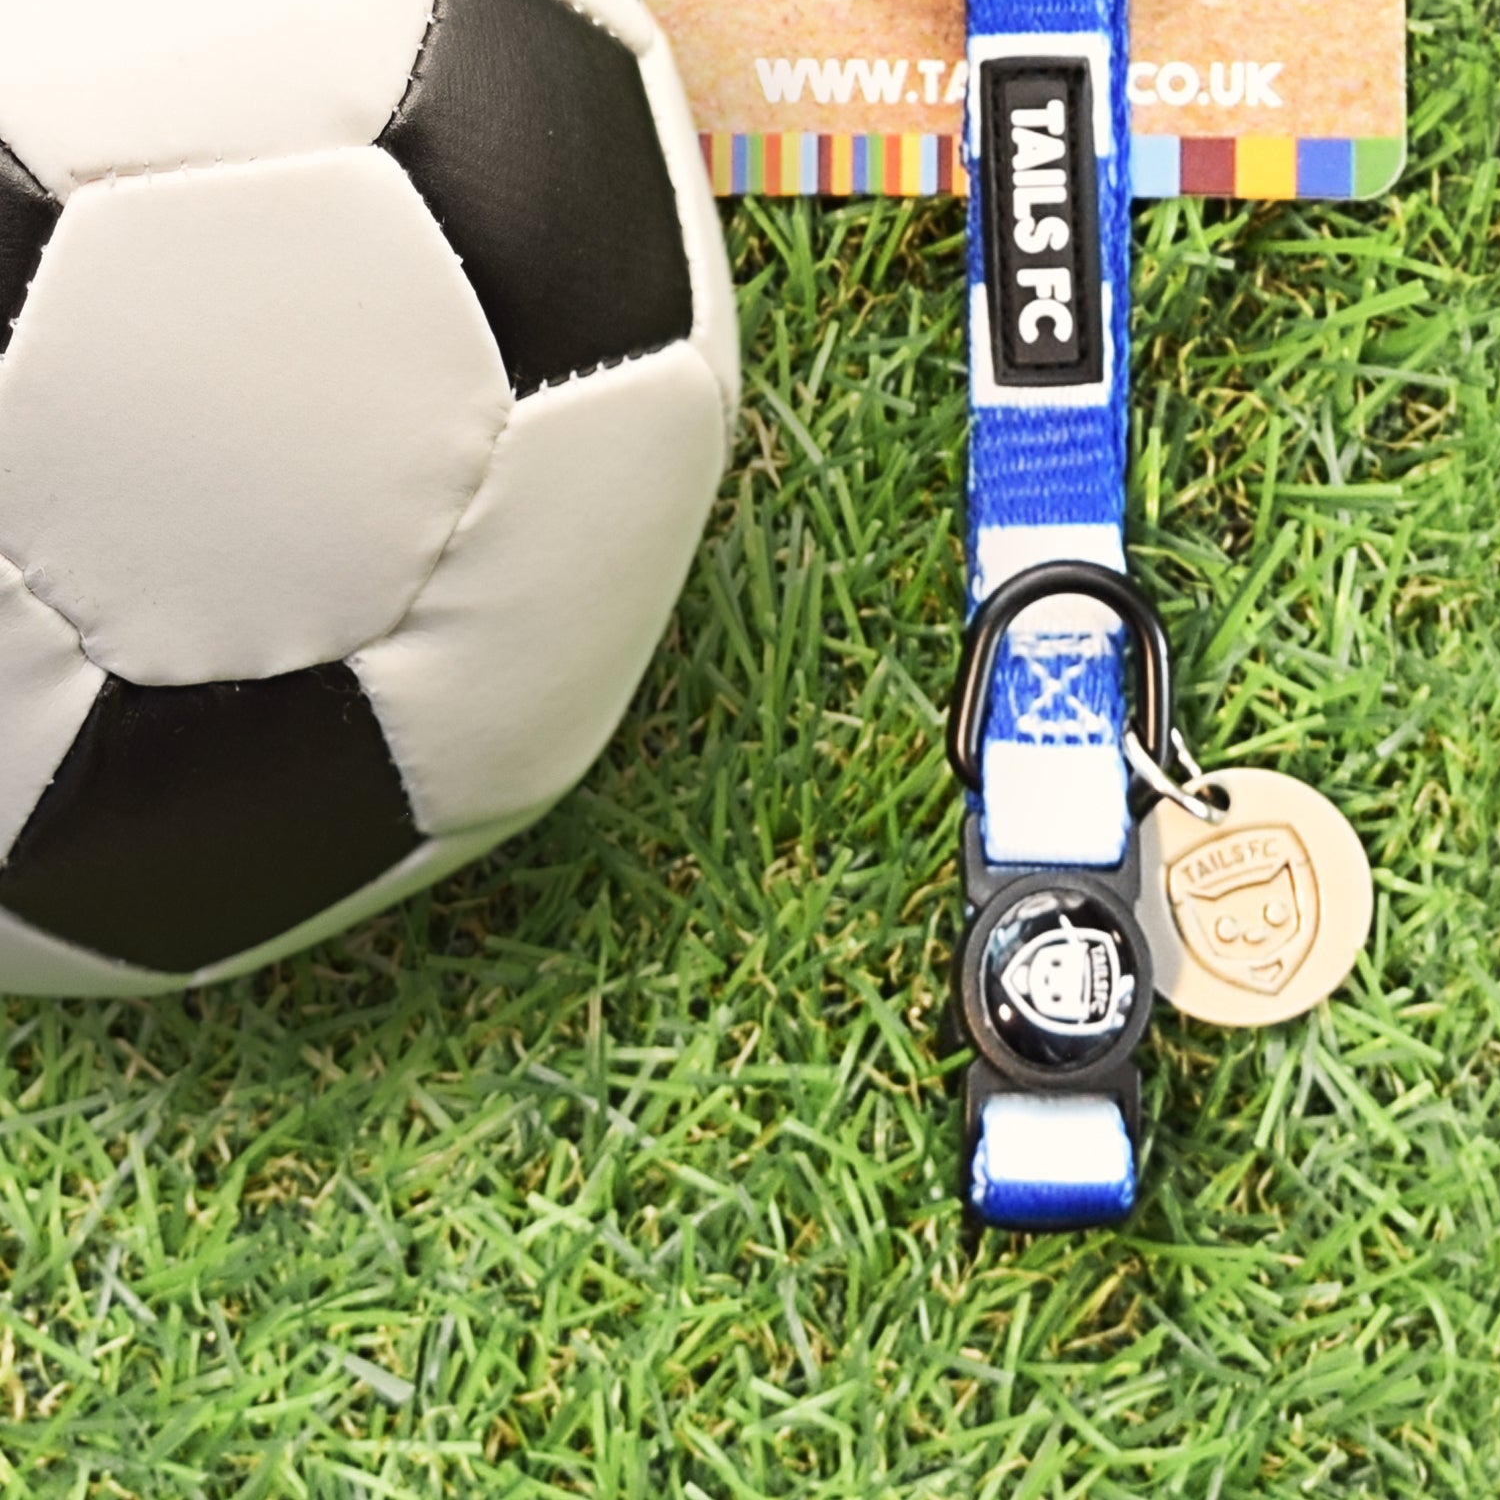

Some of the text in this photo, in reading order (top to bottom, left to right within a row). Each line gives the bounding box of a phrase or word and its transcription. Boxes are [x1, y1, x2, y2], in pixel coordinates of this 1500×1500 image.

[1010, 99, 1073, 344] TAILS FC
[1182, 838, 1278, 884] TAILS FC
